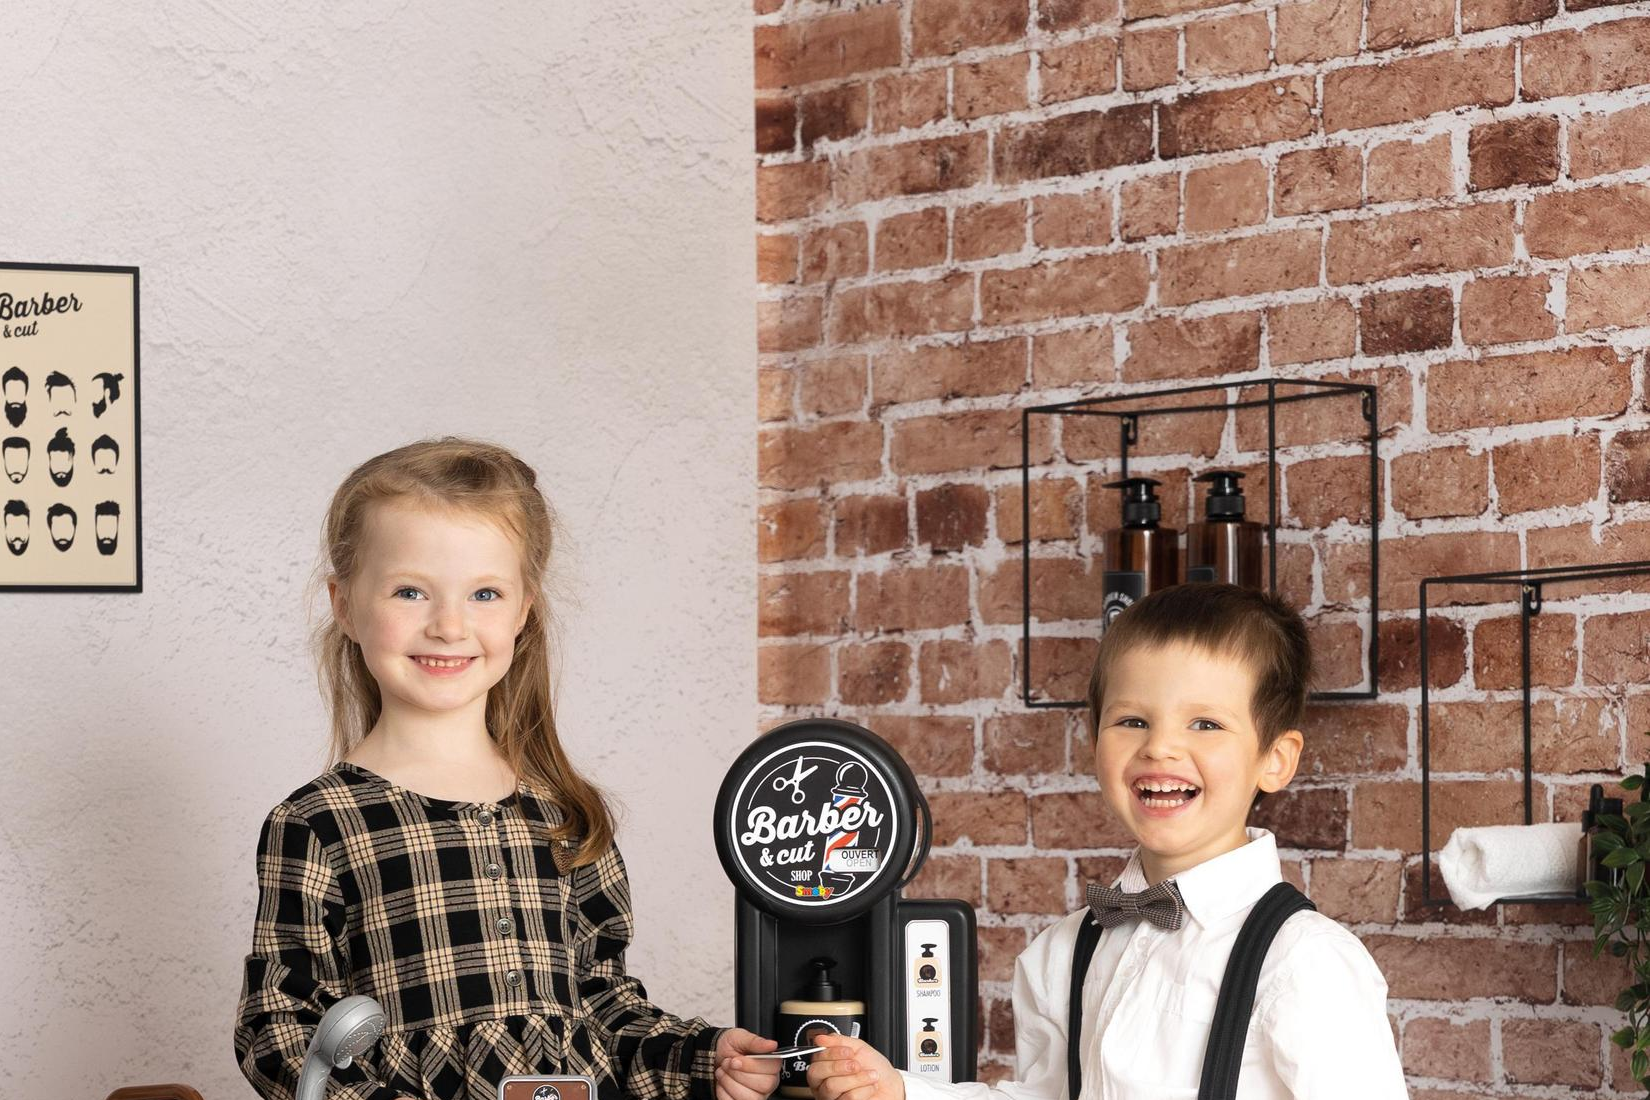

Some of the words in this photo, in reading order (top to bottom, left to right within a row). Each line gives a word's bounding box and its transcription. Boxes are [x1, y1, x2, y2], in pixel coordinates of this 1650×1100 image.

[3, 324, 12, 338] &
[14, 320, 40, 337] cut
[741, 799, 883, 846] Barber
[759, 848, 775, 867] &
[776, 840, 816, 866] cut
[841, 850, 879, 860] OUVERT
[846, 858, 872, 868] OPEN
[790, 870, 813, 882] SHOP
[794, 884, 835, 900] Smoby
[916, 989, 941, 998] SHAMPOO
[920, 1064, 940, 1072] LOTION
